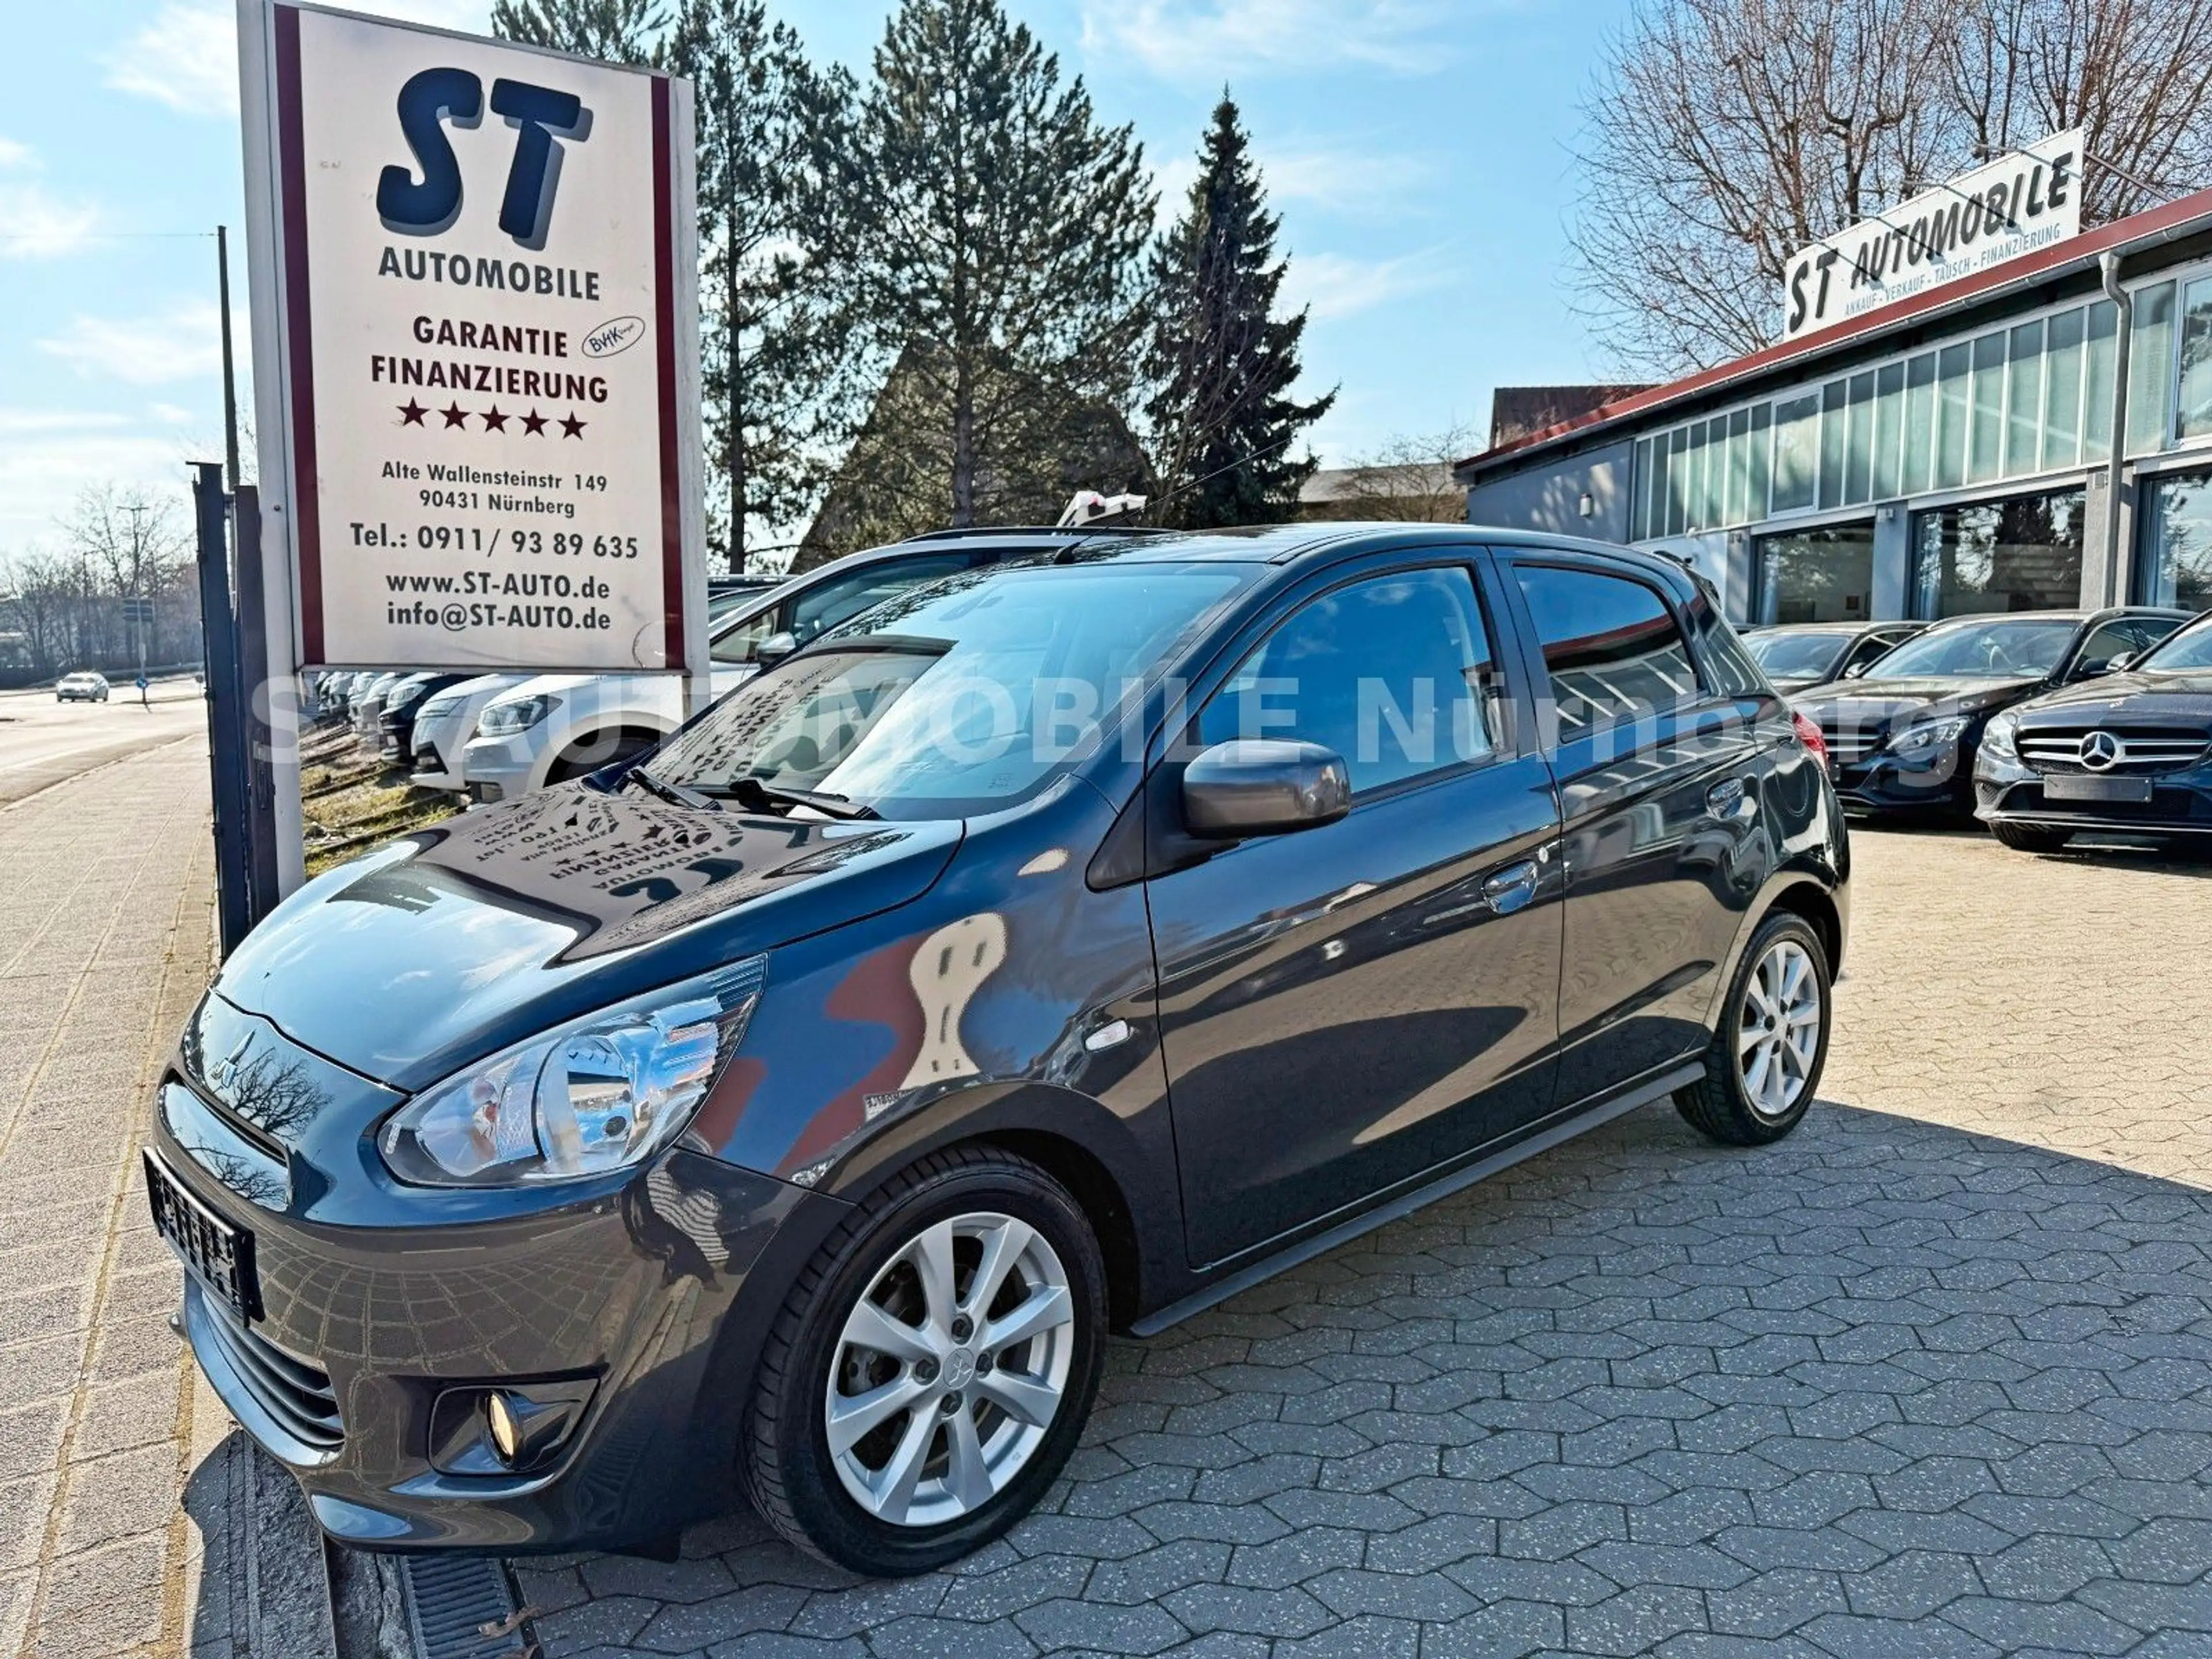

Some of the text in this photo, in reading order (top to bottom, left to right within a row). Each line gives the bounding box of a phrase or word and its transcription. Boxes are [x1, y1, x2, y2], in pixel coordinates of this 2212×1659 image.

[376, 67, 594, 251] ST
[1789, 151, 2073, 333] ST AUTOMOBILE
[378, 247, 599, 300] AUTOMOBILE
[1845, 223, 2061, 316] ANKAUF VERKAUF TAUSCH FINANZIERUNG
[413, 316, 567, 358] GARANTIE
[372, 355, 608, 403] FINANZIERUNG
[382, 461, 607, 491] Alte Wallensteinstr 149
[420, 490, 574, 518] 90431 Nürnberg
[350, 523, 407, 547] Tel.:
[512, 531, 542, 554] 93
[554, 533, 583, 555] 89
[594, 536, 638, 558] 635
[386, 571, 609, 599] www.ST-AUTO.de
[388, 601, 611, 631] info@ST-AUTO.de
